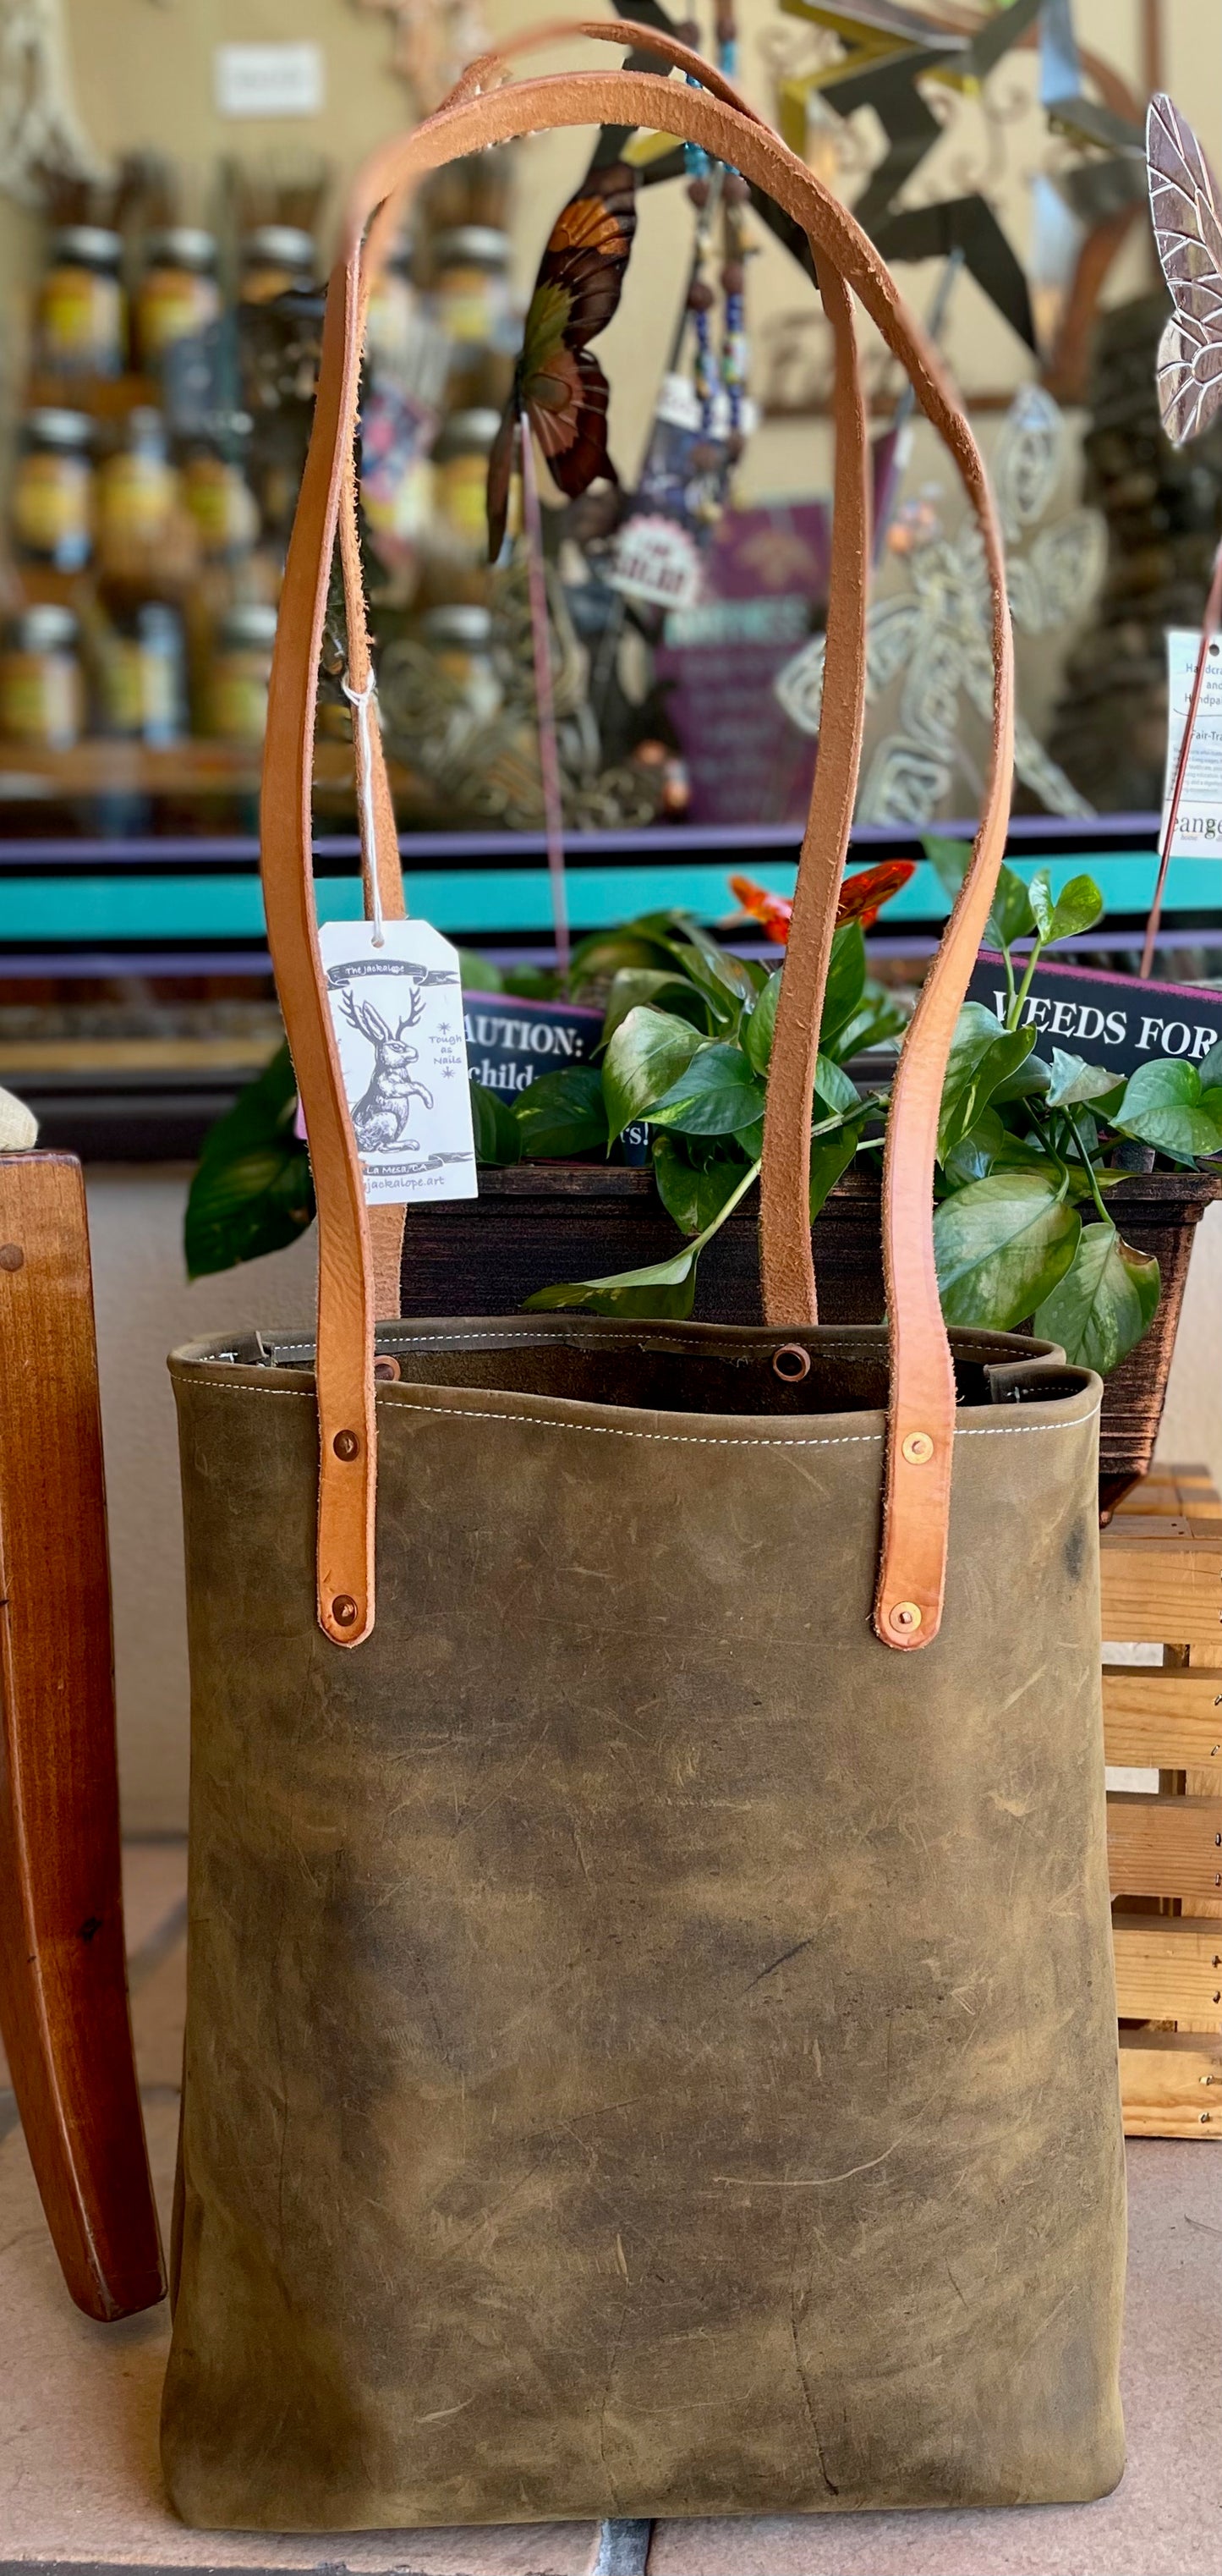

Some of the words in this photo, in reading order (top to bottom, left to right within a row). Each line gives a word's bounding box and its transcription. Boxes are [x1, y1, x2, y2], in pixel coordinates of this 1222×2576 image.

[429, 1035, 463, 1046] Tough
[464, 1014, 584, 1057] AUTION:
[1135, 1016, 1218, 1059] FOR
[434, 1055, 462, 1064] Nails
[409, 1163, 428, 1172] CA
